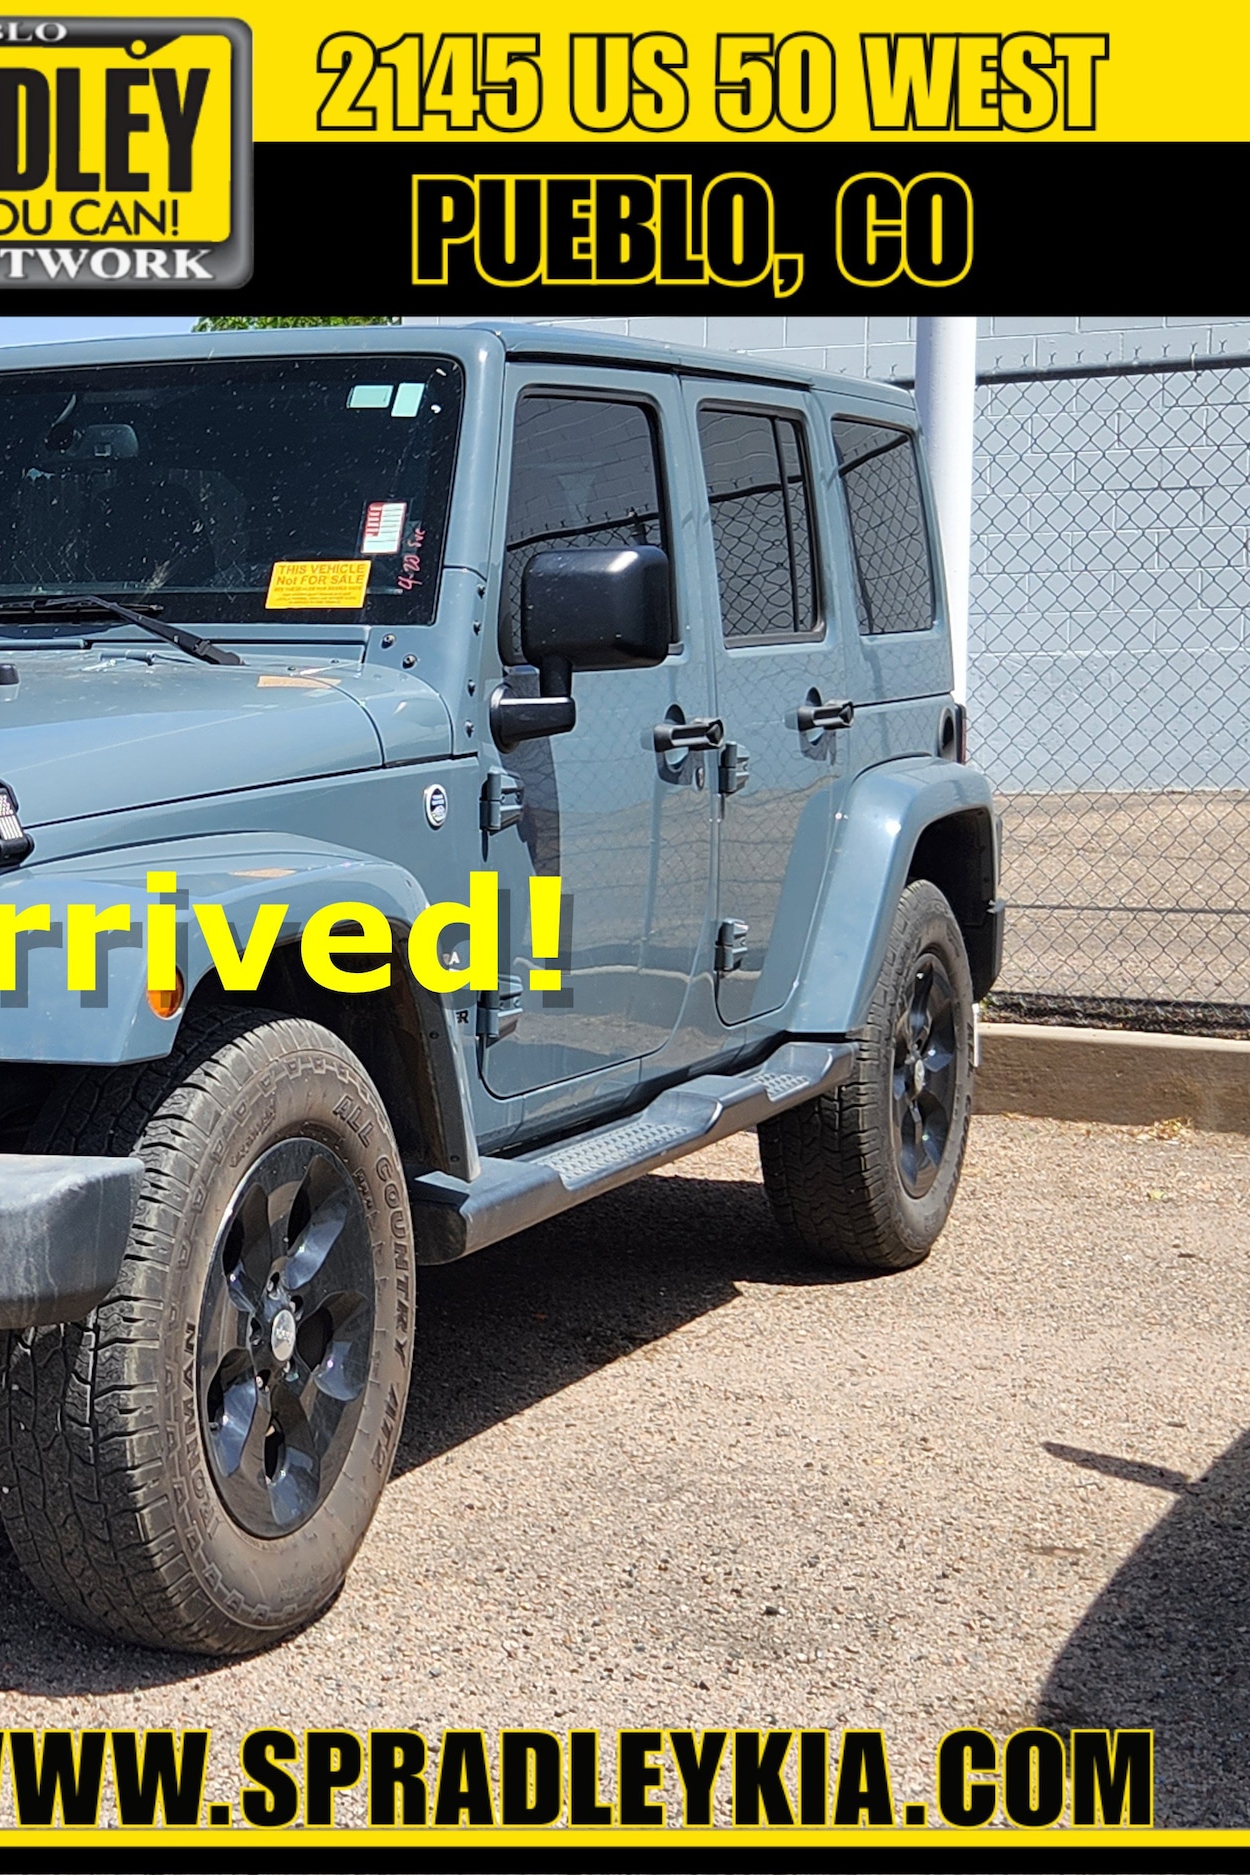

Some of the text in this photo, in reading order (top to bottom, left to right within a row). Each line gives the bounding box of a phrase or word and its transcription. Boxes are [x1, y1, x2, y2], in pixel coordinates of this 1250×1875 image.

[279, 563, 366, 575] THIS VEHICLE
[300, 575, 326, 585] FOR
[330, 574, 365, 585] SALE
[333, 1094, 374, 1148] ALL
[375, 1155, 411, 1368] COUNTRY
[181, 1322, 222, 1541] IRONMAN
